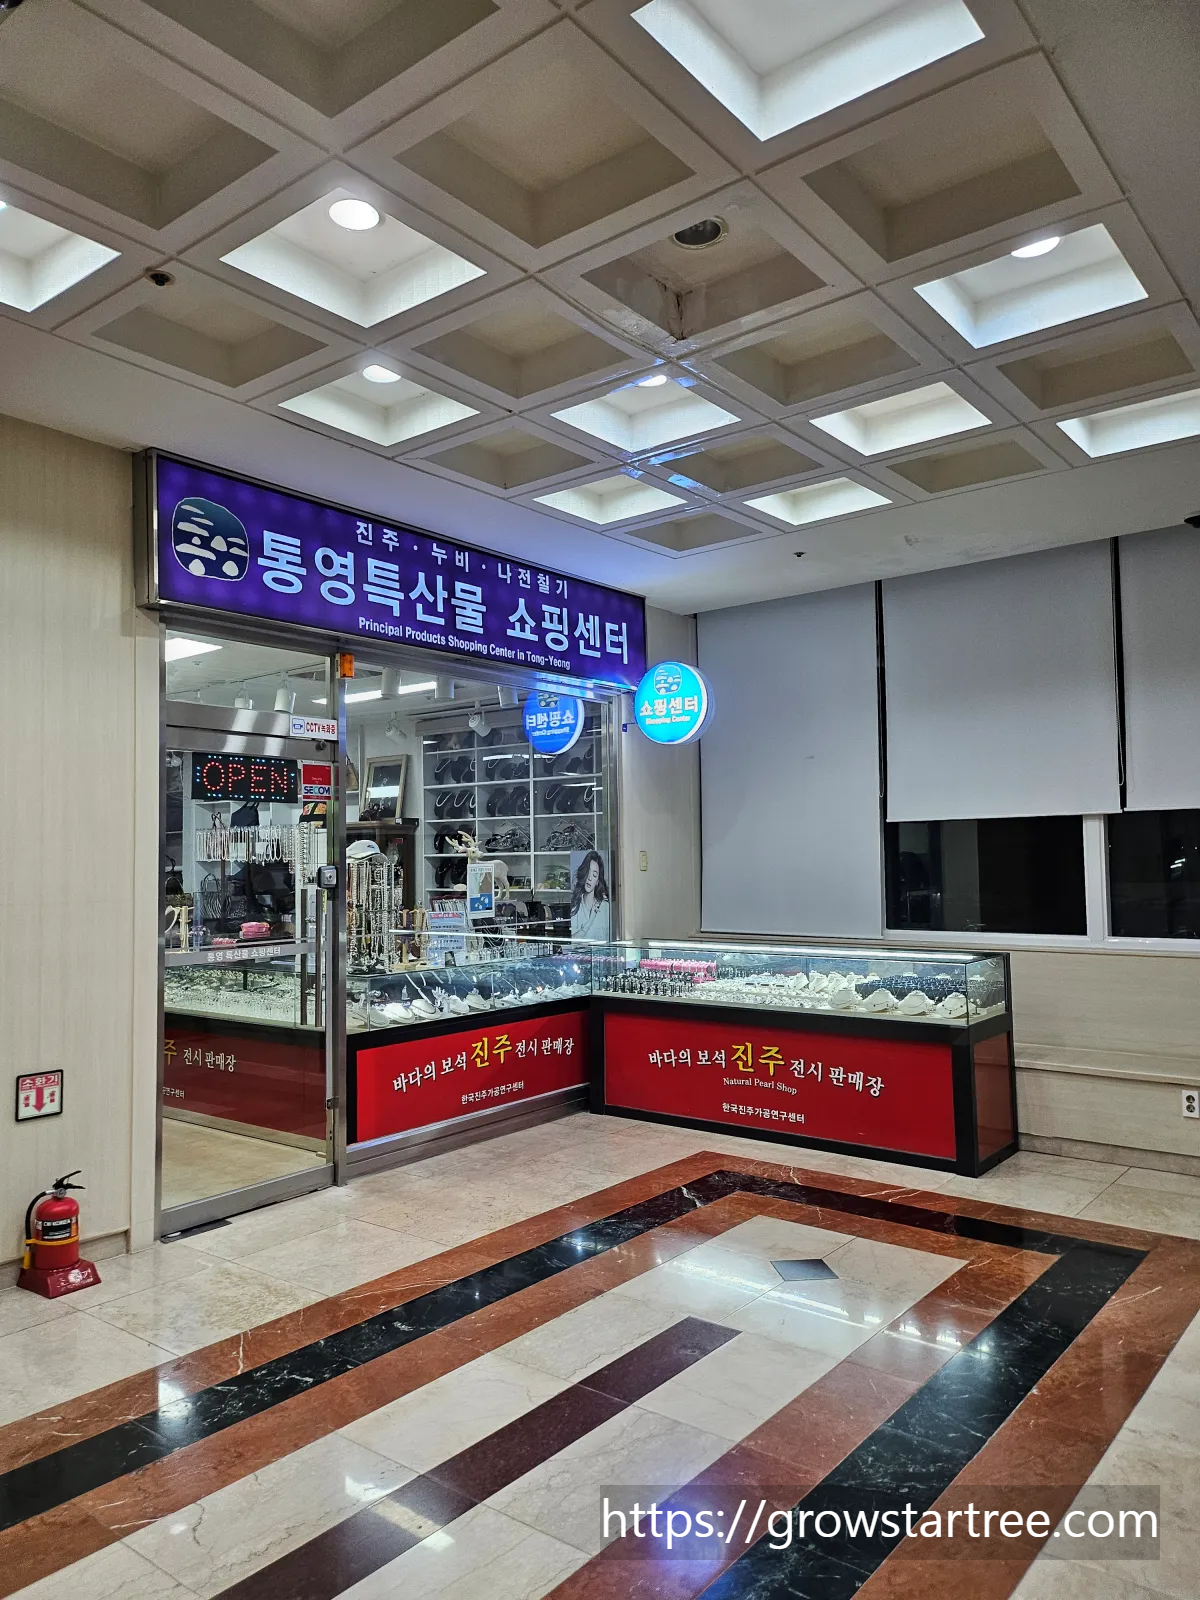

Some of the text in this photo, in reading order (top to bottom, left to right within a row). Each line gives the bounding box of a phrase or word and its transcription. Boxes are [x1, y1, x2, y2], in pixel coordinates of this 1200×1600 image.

[355, 520, 568, 599] 진주 누비 나전칠기
[257, 529, 629, 665] 통영특산물 쇼핑센터
[358, 616, 571, 671] Principal Products Shopping Center in Tong-Yeong
[640, 695, 699, 716] 쇼핑센터
[203, 761, 288, 793] OPEN
[303, 785, 331, 795] SECOM
[164, 1039, 237, 1073] 주 전시 판매장
[392, 1034, 575, 1093] 바다의 보석 진주 전시 판매장
[647, 1042, 885, 1098] 바다의 보석 진주 전시 판매장
[22, 1074, 58, 1087] 소화기
[461, 1080, 525, 1105] 한국진주가공연구센터
[722, 1076, 798, 1096] Natural Pearl Shop
[722, 1102, 805, 1125] 한국진주가공연구센터
